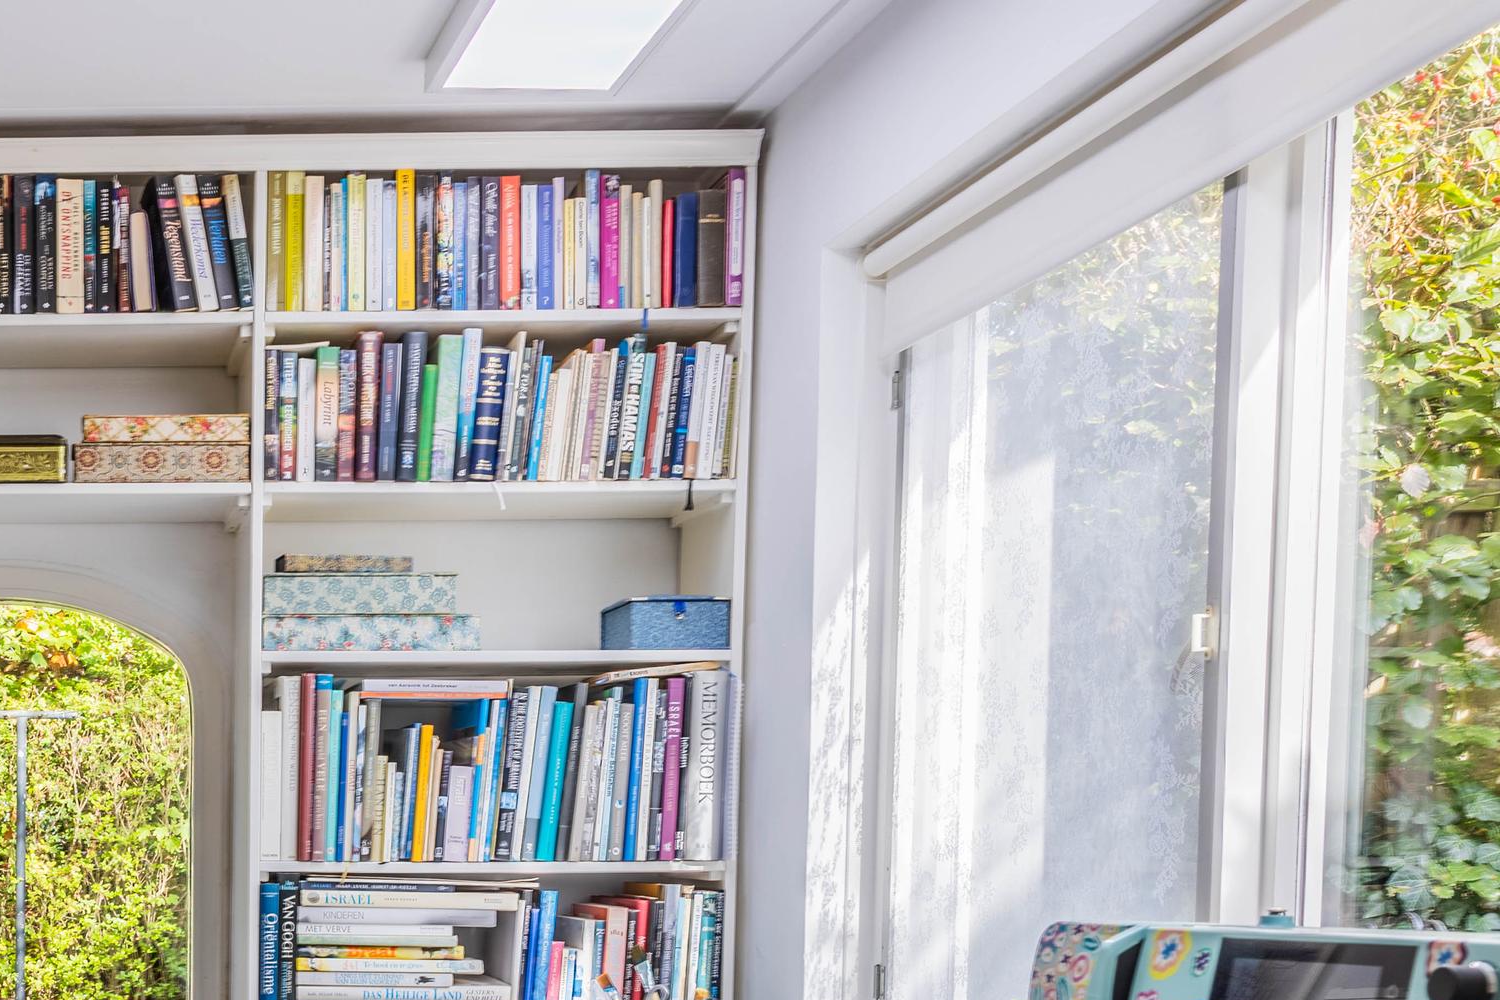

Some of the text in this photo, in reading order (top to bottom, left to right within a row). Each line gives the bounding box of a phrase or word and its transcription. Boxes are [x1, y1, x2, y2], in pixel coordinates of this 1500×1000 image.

[39, 206, 47, 240] ROSENBERG
[100, 189, 110, 222] OPERATIE
[61, 192, 72, 280] DE ONTSNAPPING
[164, 220, 192, 282] Tegenstand
[189, 218, 209, 280] Wederkomst
[209, 220, 228, 265] Verlaten
[271, 222, 281, 256] VERHALEN
[0, 254, 9, 298] HET DERDE
[24, 255, 32, 297] DE EERSTE
[322, 381, 336, 425] Labyrint
[361, 352, 375, 426] BOOK MYSTERIES
[518, 374, 529, 400] TORA
[621, 353, 645, 451] SON HAMAS
[609, 400, 622, 437] Exodus
[288, 680, 299, 731] MENSEN
[318, 709, 327, 732] EEN
[516, 701, 527, 714] THE
[667, 701, 681, 739] ISRAËL
[512, 715, 526, 750] FOOTSTEPS
[622, 712, 631, 739] NOOIT
[698, 682, 718, 804] MEMORBOEK
[512, 751, 522, 760] OF
[289, 763, 297, 792] WERELD
[508, 760, 521, 790] ABRAHAM
[607, 761, 616, 797] Bethlehem
[323, 894, 375, 905] ISRAEL
[323, 911, 365, 920] KINDEREN
[281, 895, 295, 959] VAN GOGH
[305, 925, 322, 933] MET
[262, 913, 279, 995] Oriëntalisme
[595, 928, 606, 968] REMBRANDT
[363, 988, 462, 1000] DAS HEILIGE LAND
